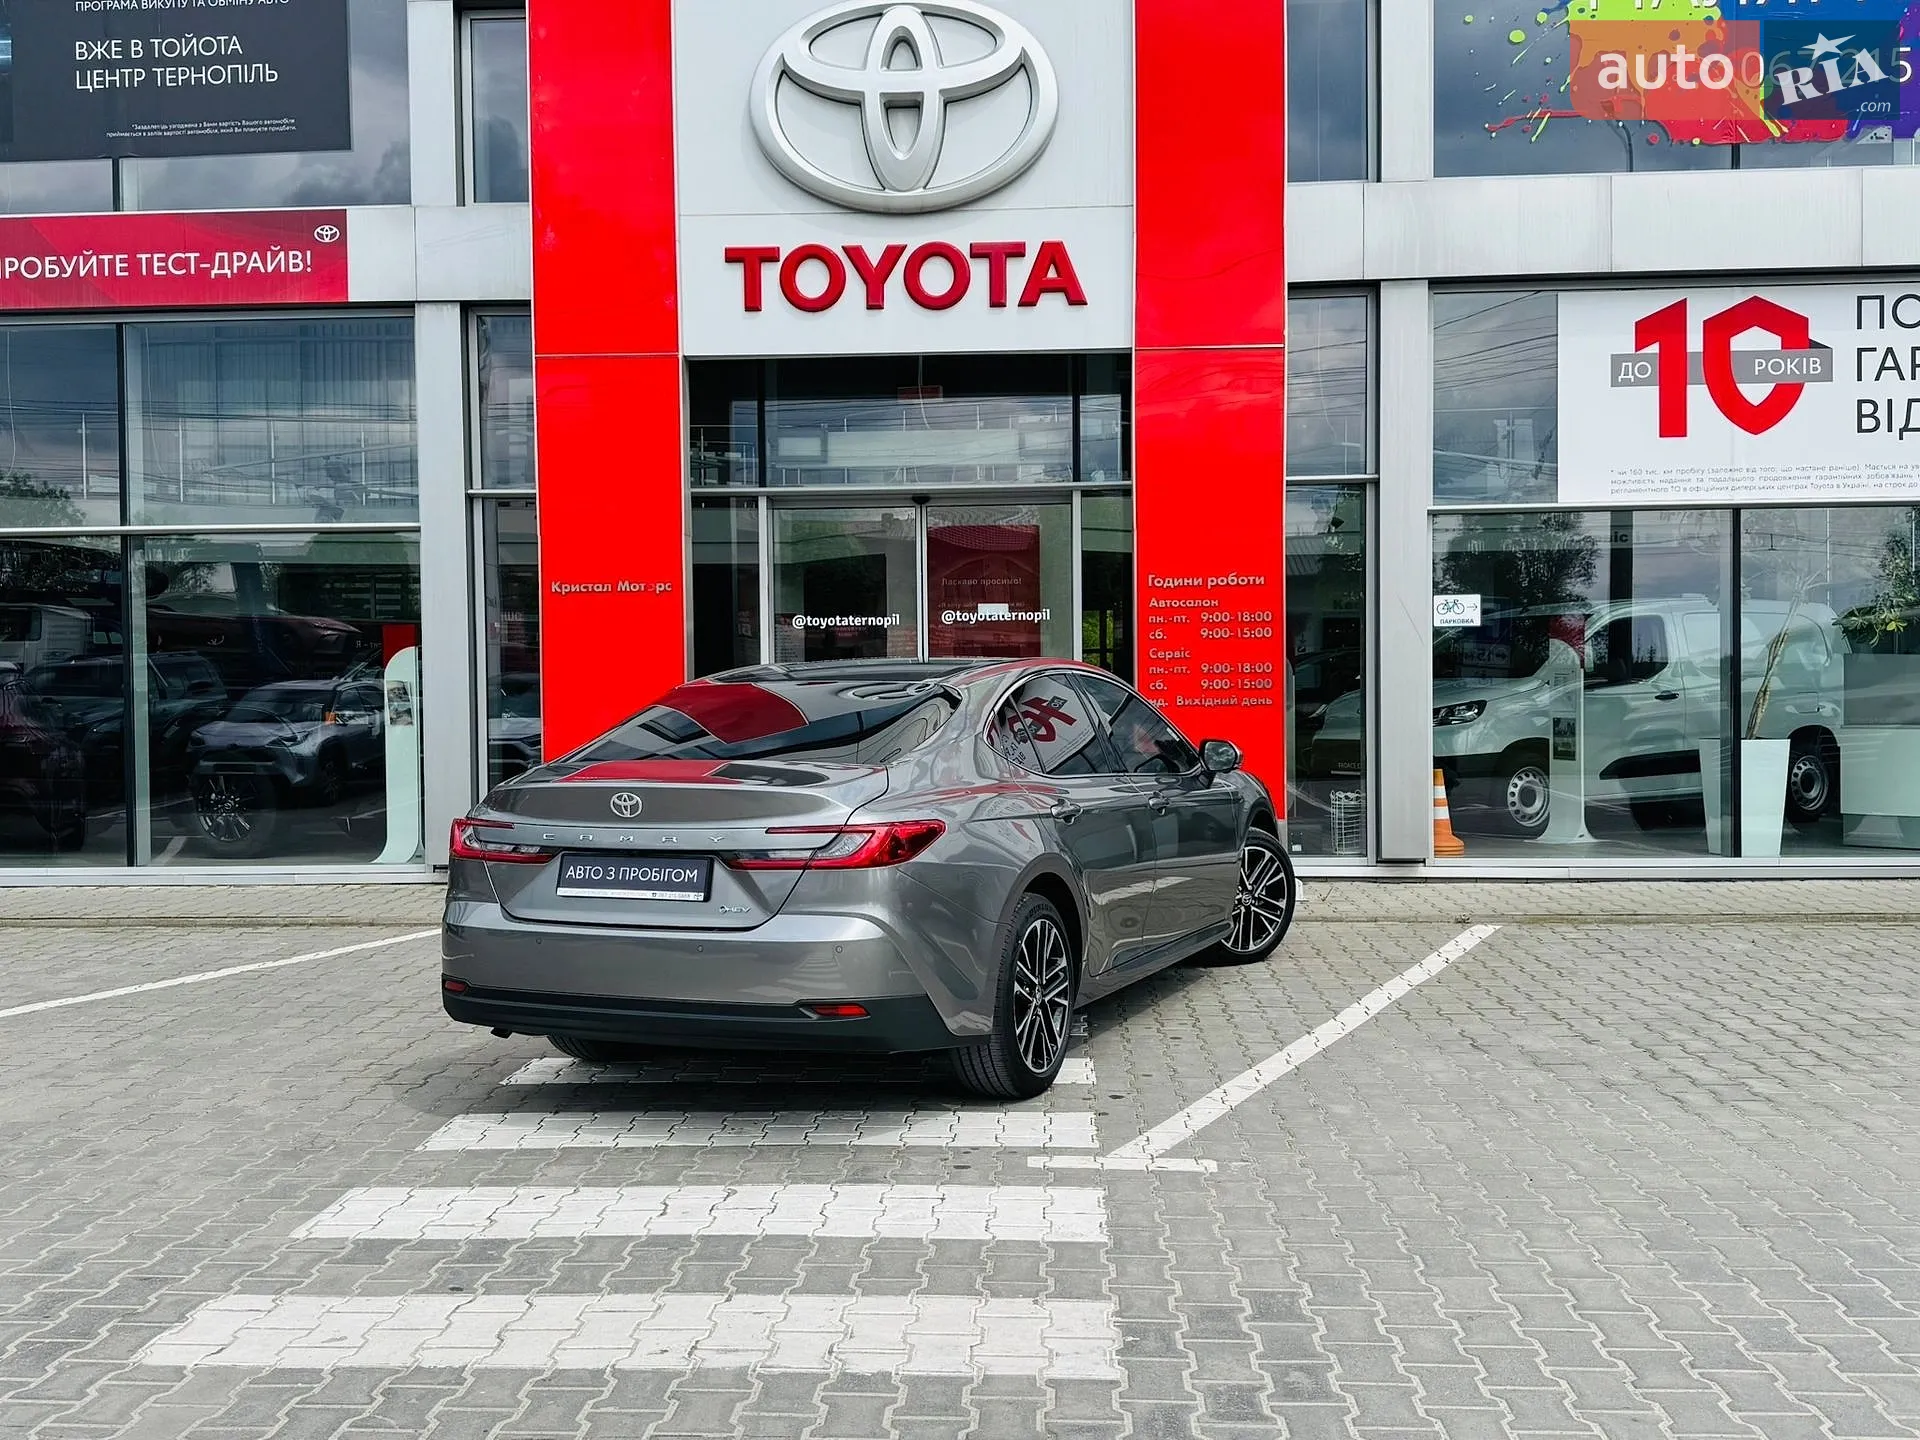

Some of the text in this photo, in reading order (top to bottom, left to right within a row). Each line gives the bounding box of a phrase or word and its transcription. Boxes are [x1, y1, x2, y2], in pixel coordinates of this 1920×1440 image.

[75, 0, 139, 12] ПРОГРАМА
[75, 33, 243, 61] ВЖЕ В ТОЙОТА
[75, 63, 279, 93] ЦЕНТР ТЕРНОПІЛЬ
[136, 246, 313, 279] ТЕСТ-ДРАЙВ!
[724, 241, 1089, 313] TOYOTA
[1857, 294, 1920, 330] ПО
[1618, 295, 1822, 438] ДО 10 РОКІВ
[1857, 398, 1920, 441] ВІД
[551, 581, 612, 595] Кристал
[1148, 572, 1265, 589] Години роботи
[1149, 597, 1219, 608] Автосалон
[791, 613, 900, 629] @toyotaternopil
[941, 609, 1051, 625] @toyotaternopil
[1149, 628, 1167, 640] сб.
[1149, 647, 1191, 661] Сервіс
[1149, 679, 1168, 690] сб.
[1176, 694, 1238, 706] Вихідний
[1241, 697, 1273, 707] день
[543, 833, 725, 843] CAMRY
[566, 865, 602, 880] АВТО
[619, 867, 698, 883] ПРОБІГОМ
